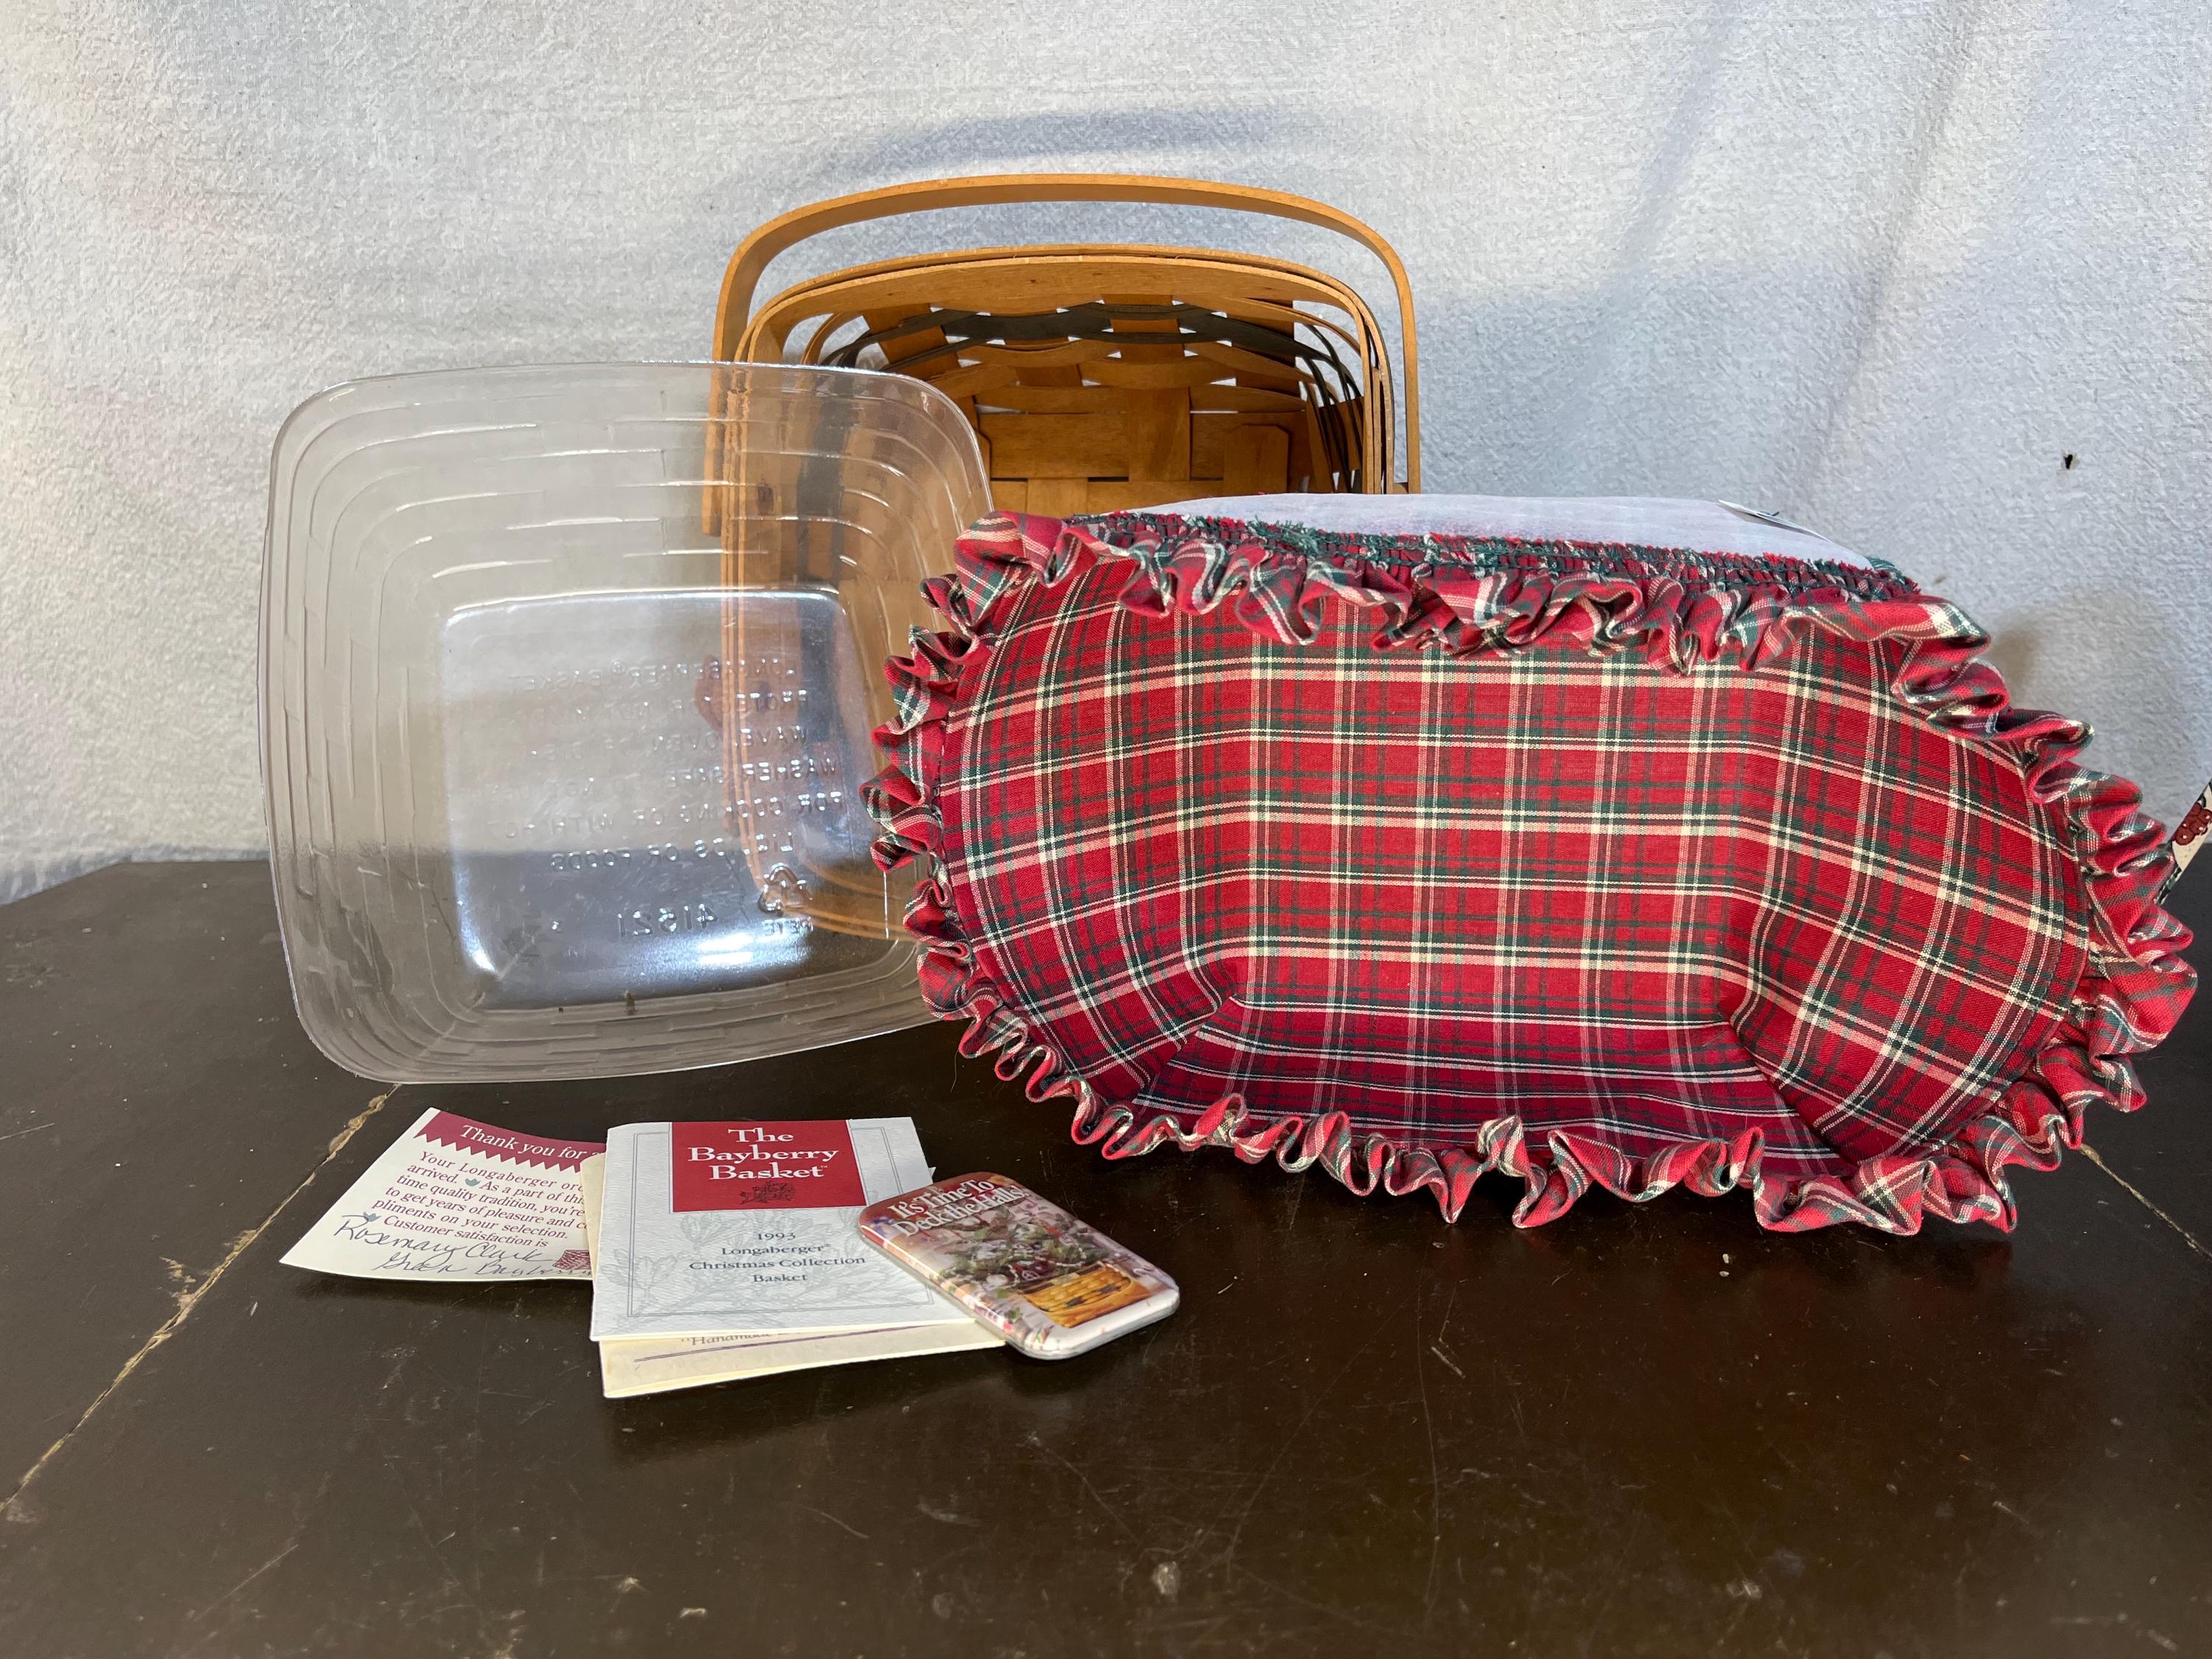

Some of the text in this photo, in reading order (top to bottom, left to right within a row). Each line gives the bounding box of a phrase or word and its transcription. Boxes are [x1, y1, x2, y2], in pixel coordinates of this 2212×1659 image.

[460, 1124, 588, 1160] Thank you for
[728, 1127, 794, 1143] The
[420, 1151, 456, 1169] Your
[459, 1163, 557, 1188] Longaberger
[687, 1144, 839, 1164] Bayberry
[397, 1175, 428, 1190] time
[430, 1185, 478, 1202] quality
[479, 1193, 538, 1211] tradition,
[407, 1164, 459, 1183] arrived.
[479, 1181, 499, 1192] As
[501, 1185, 511, 1194] a
[512, 1188, 544, 1199] part
[546, 1192, 566, 1201] of
[914, 1187, 973, 1209] Time
[961, 1179, 994, 1193] To
[372, 1199, 568, 1239] pliments on your selection.
[386, 1186, 400, 1197] to
[400, 1192, 428, 1204] get
[425, 1197, 467, 1213] years
[469, 1206, 487, 1215] of
[483, 1208, 544, 1224] pleasure
[546, 1218, 575, 1229] and
[891, 1210, 953, 1238] Deck
[942, 1200, 981, 1220] the
[383, 1215, 549, 1248] Customer satisfaction is
[757, 1232, 796, 1241] 1993
[689, 1256, 866, 1270] Christmas Collection
[754, 1273, 808, 1283] Basket
